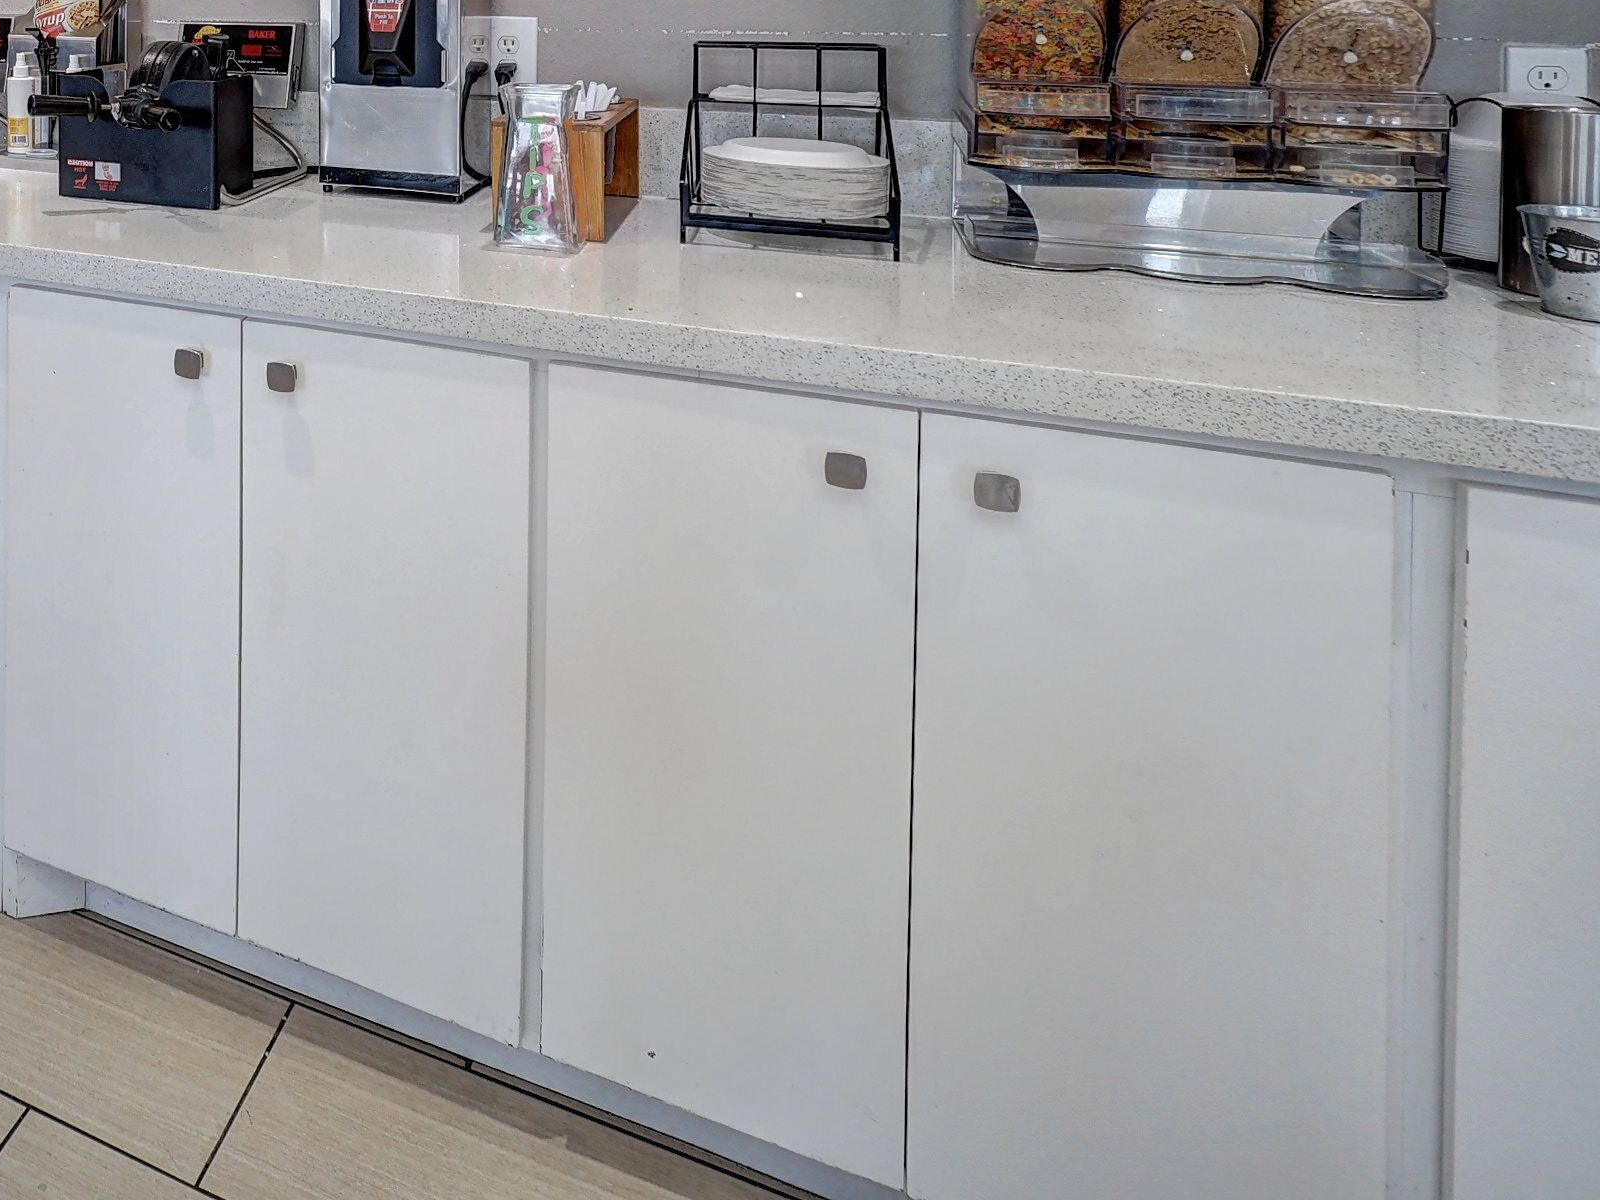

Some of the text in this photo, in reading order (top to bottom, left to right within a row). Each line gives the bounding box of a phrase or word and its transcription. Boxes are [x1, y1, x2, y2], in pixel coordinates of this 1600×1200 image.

[248, 30, 276, 39] BAKER
[67, 159, 93, 167] CAUTION
[1566, 247, 1600, 266] ME
